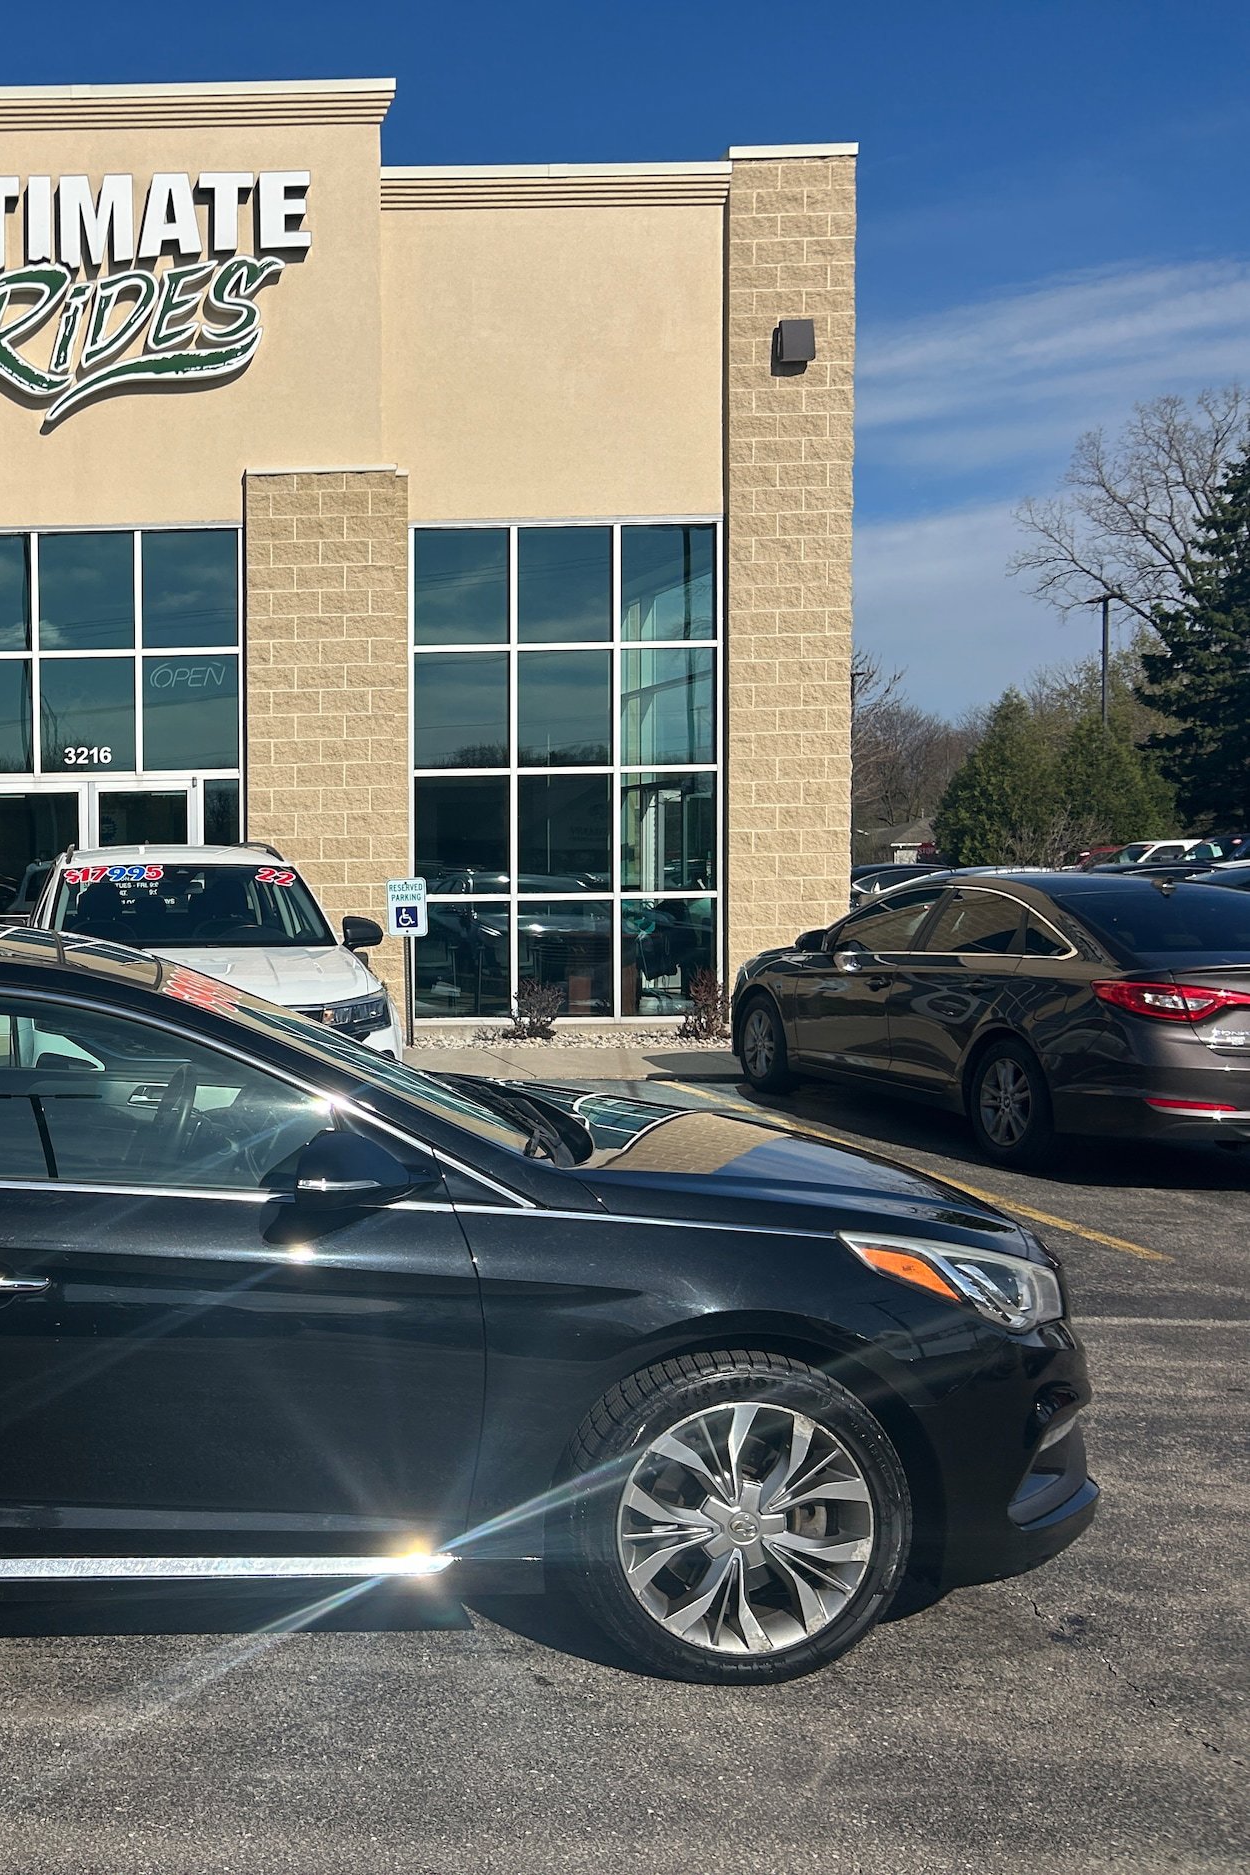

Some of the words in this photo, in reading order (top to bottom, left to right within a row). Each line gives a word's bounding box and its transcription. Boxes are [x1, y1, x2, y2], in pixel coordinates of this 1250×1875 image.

[152, 665, 226, 688] OPEN
[63, 746, 112, 765] 3216
[64, 865, 164, 884] $17995
[254, 867, 297, 887] 22
[388, 883, 423, 892] RESERVED
[391, 893, 422, 901] PARKING
